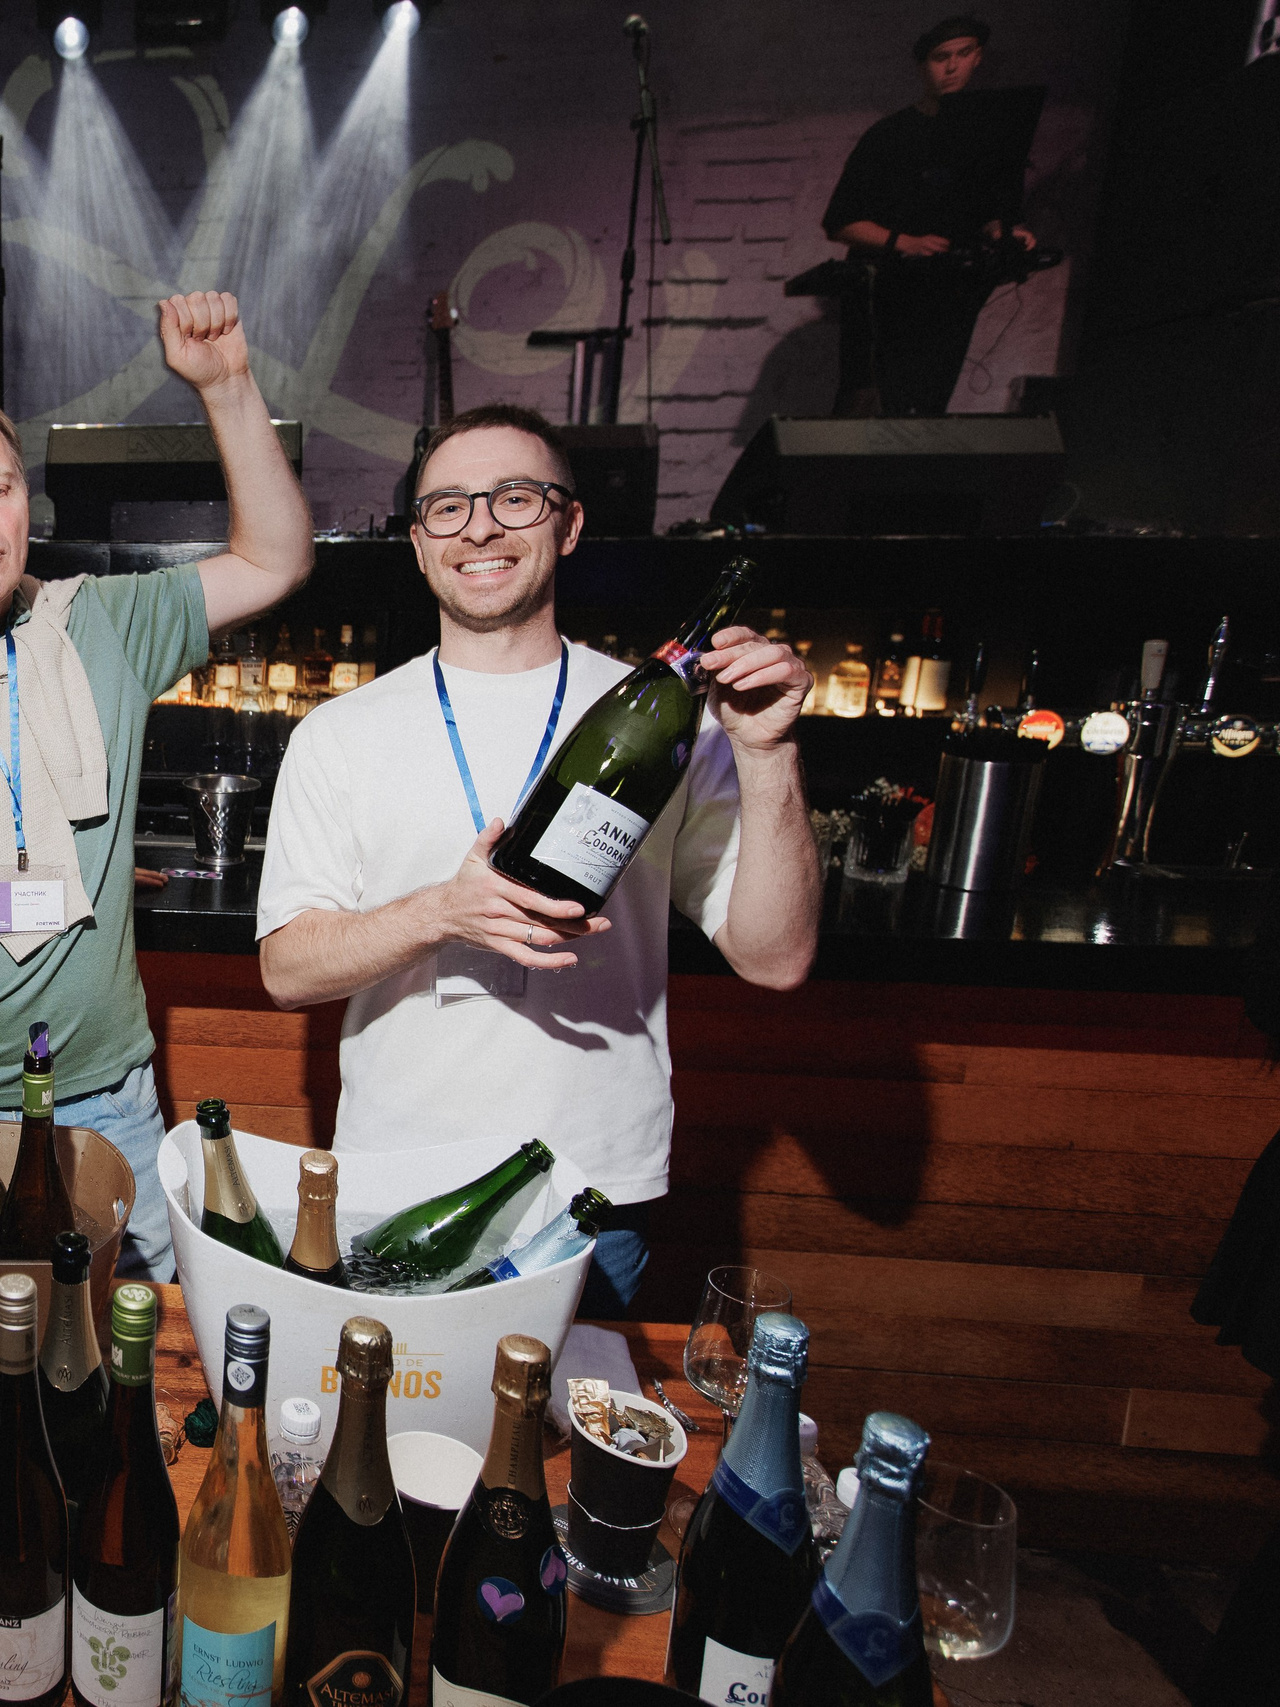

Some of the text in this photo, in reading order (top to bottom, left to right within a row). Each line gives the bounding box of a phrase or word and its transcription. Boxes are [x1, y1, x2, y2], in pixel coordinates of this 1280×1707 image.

[597, 820, 638, 852] ANNA
[583, 870, 603, 886] BRUT
[405, 1358, 424, 1367] DE
[320, 1365, 442, 1399] BNOS
[193, 1643, 264, 1669] ERNST LUDWIG
[320, 1682, 395, 1704] ALTEMASI
